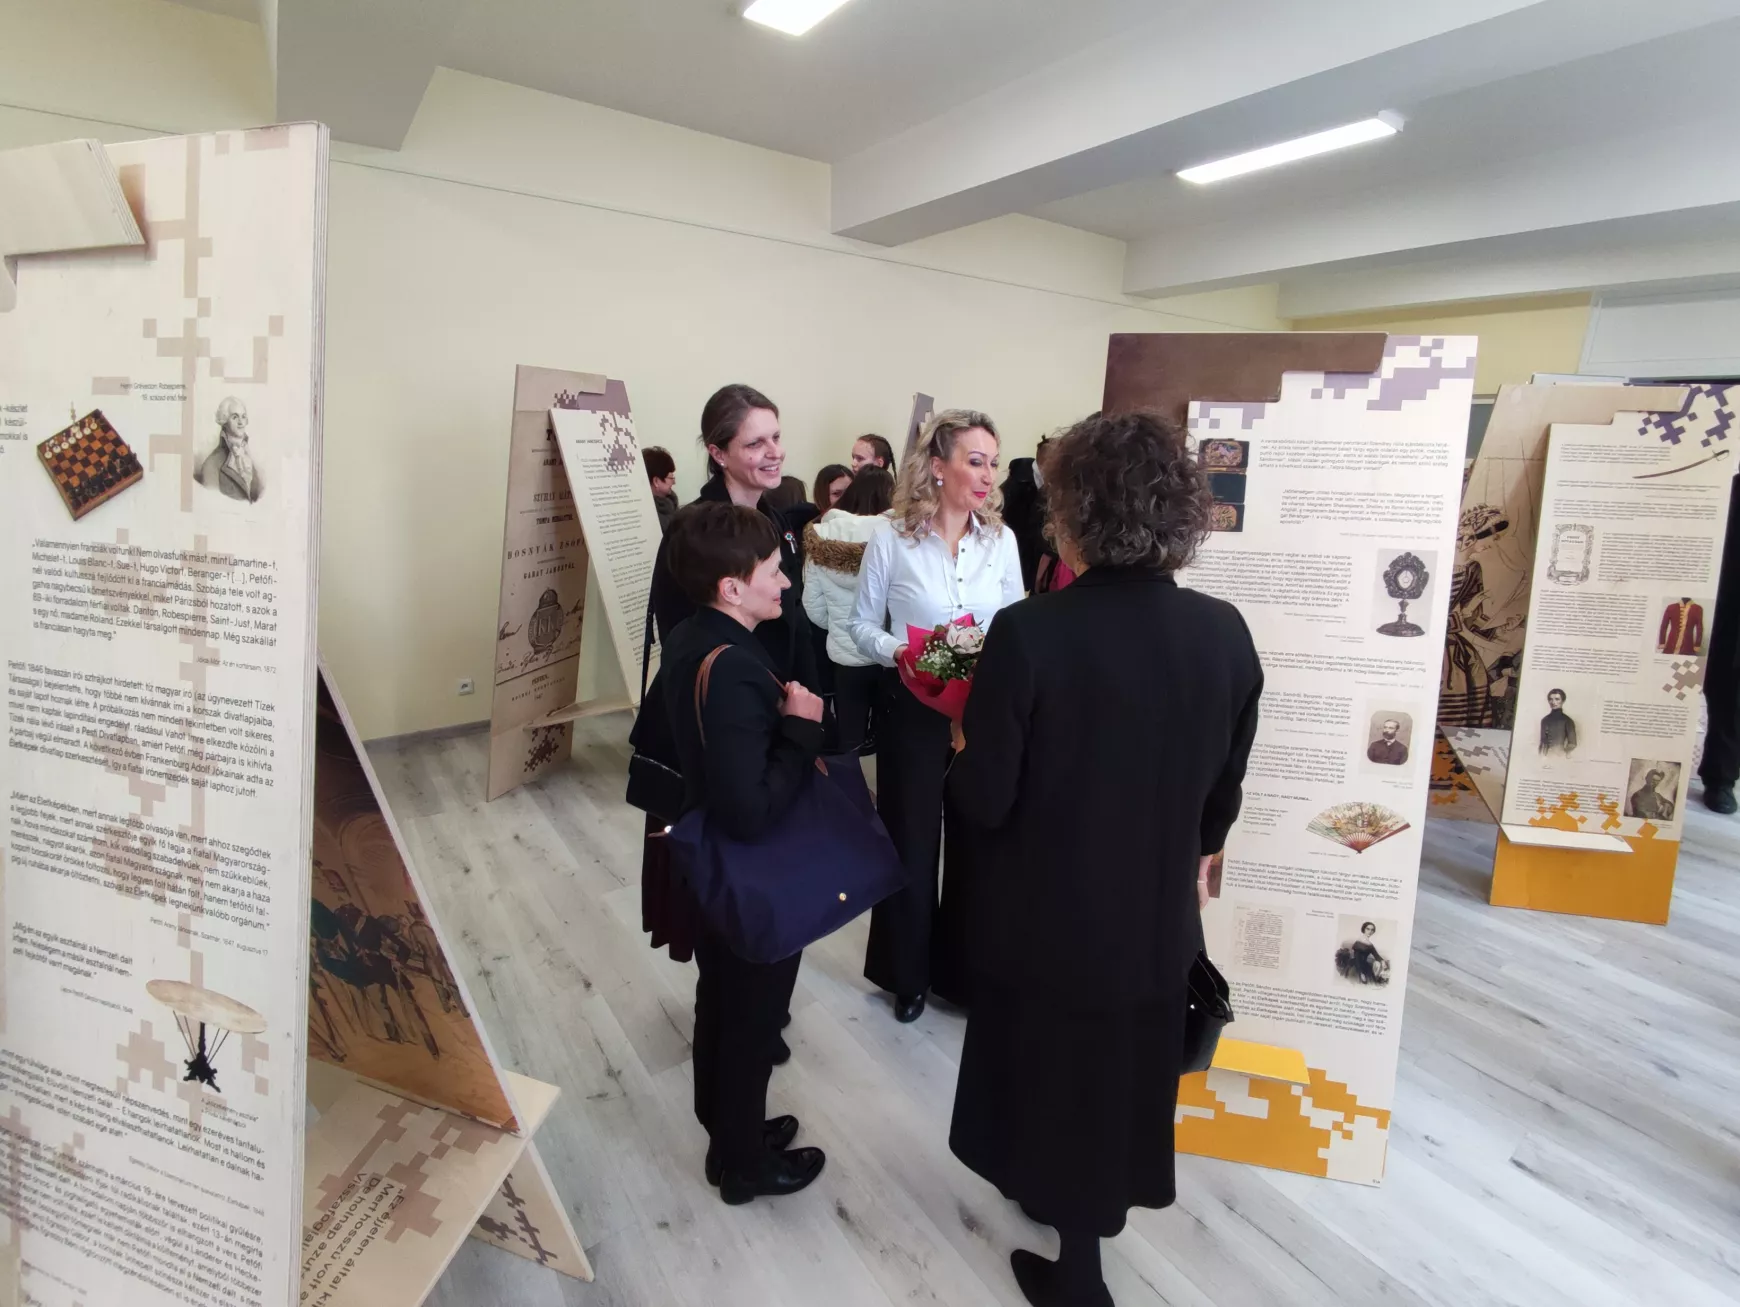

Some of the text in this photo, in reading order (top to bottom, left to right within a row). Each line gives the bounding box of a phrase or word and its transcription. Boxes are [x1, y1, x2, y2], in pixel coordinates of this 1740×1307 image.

[68, 554, 86, 565] Louis
[116, 560, 138, 572] Sue-t,
[140, 562, 158, 575] Hugo
[136, 546, 152, 557] Nem
[153, 548, 188, 560] olvastunk
[188, 552, 209, 564] mást,
[210, 554, 227, 564] mint
[508, 543, 554, 560] BOSNYÁK
[97, 571, 125, 583] fejlődött
[195, 583, 226, 596] Szobája
[228, 586, 243, 597] tele
[245, 589, 260, 599] volt
[262, 593, 276, 603] ag-
[133, 604, 276, 632] Danton, Robespierre, Saint-Just, Marat
[152, 593, 270, 615] miket Párizsból azok
[73, 626, 95, 638] hagyta
[115, 616, 142, 629] Ezekkel
[143, 620, 176, 634] társalgott
[223, 630, 240, 643] Még
[241, 634, 276, 646] szakállát
[84, 685, 274, 729] hogy többé kívánnak korszak divatlapjaiba,
[155, 686, 181, 697] magyar
[207, 692, 252, 708] úgynevezett
[254, 700, 275, 712] Tízek
[99, 703, 274, 743] próbálkozás minden tekintetben volt sikeres,
[81, 725, 97, 737] Pesti
[141, 738, 162, 750] amiért
[164, 742, 186, 754] Petőfi
[205, 750, 236, 765] párbajra
[134, 722, 267, 756] ráadásul Vahot Imre elkezdte közölni
[124, 748, 144, 760] évben
[145, 752, 189, 772] Frankenburg
[190, 761, 210, 774] Adolf
[211, 766, 244, 781] Jókainak
[246, 774, 263, 785] adta
[264, 779, 273, 787] az
[127, 762, 144, 774] fiatal
[145, 766, 189, 784] írónemzedék
[190, 777, 208, 788] saját
[209, 779, 234, 793] laphoz
[82, 808, 271, 860] mert annak legtöbb olvasója van, mert ahhoz szegődtek
[167, 840, 185, 854] tagja
[192, 847, 211, 860] fiatal
[213, 852, 270, 876] Magyarország-
[112, 868, 254, 912] hogy folt hátán hanem tetőtől
[124, 887, 132, 895] az
[133, 887, 167, 905] Életképek
[222, 884, 270, 903] akarja haza
[204, 1138, 221, 1152] Most
[230, 1148, 254, 1165] hallom
[256, 1158, 264, 1169] és
[362, 1177, 381, 1194] De
[368, 1183, 395, 1213] Mert
[327, 1196, 366, 1240] holnap
[331, 1213, 371, 1260] hosszú
[354, 1212, 391, 1256] éjjelen
[309, 1263, 332, 1290] volt
[329, 1258, 355, 1289] által
